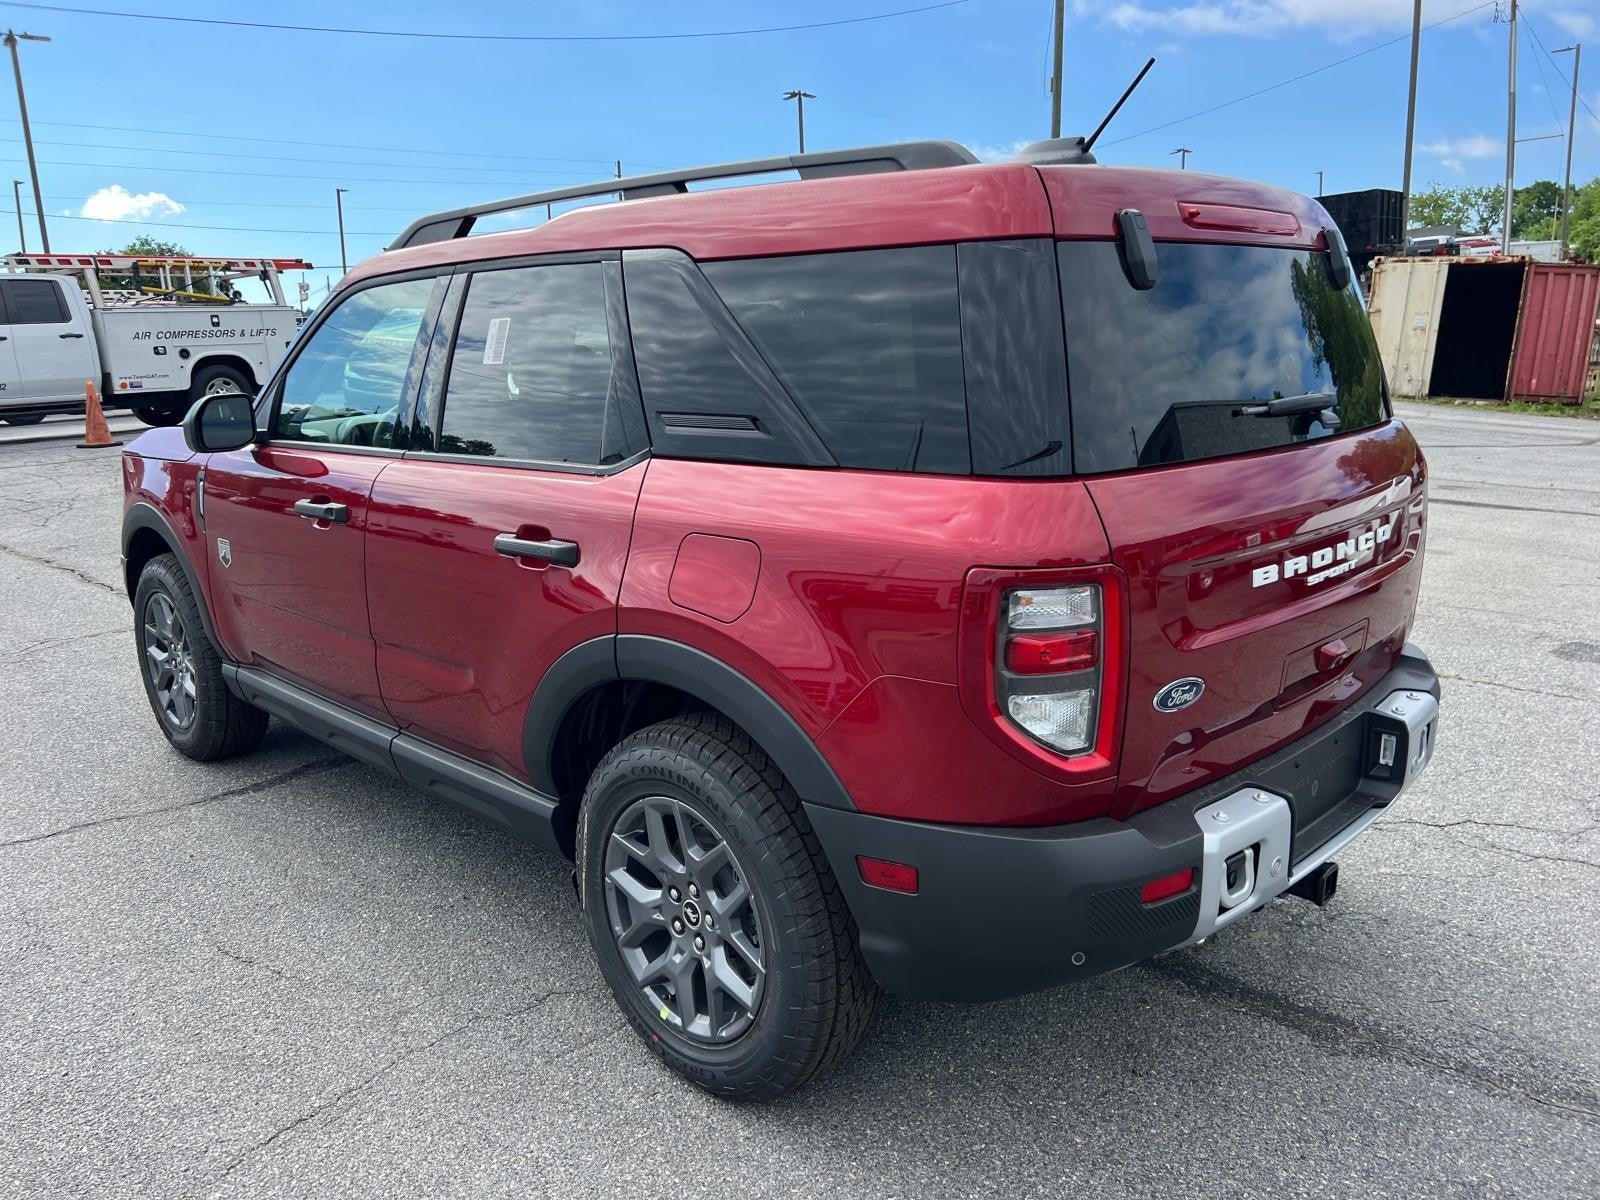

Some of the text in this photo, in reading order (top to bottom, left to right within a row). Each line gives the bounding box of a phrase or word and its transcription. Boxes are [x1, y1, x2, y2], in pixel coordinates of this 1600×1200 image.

[132, 328, 277, 341] AIR COMPRESSORS & LIFTS
[1252, 523, 1392, 588] BRONCO
[1306, 559, 1356, 587] SPORT
[1167, 685, 1197, 707] Ford
